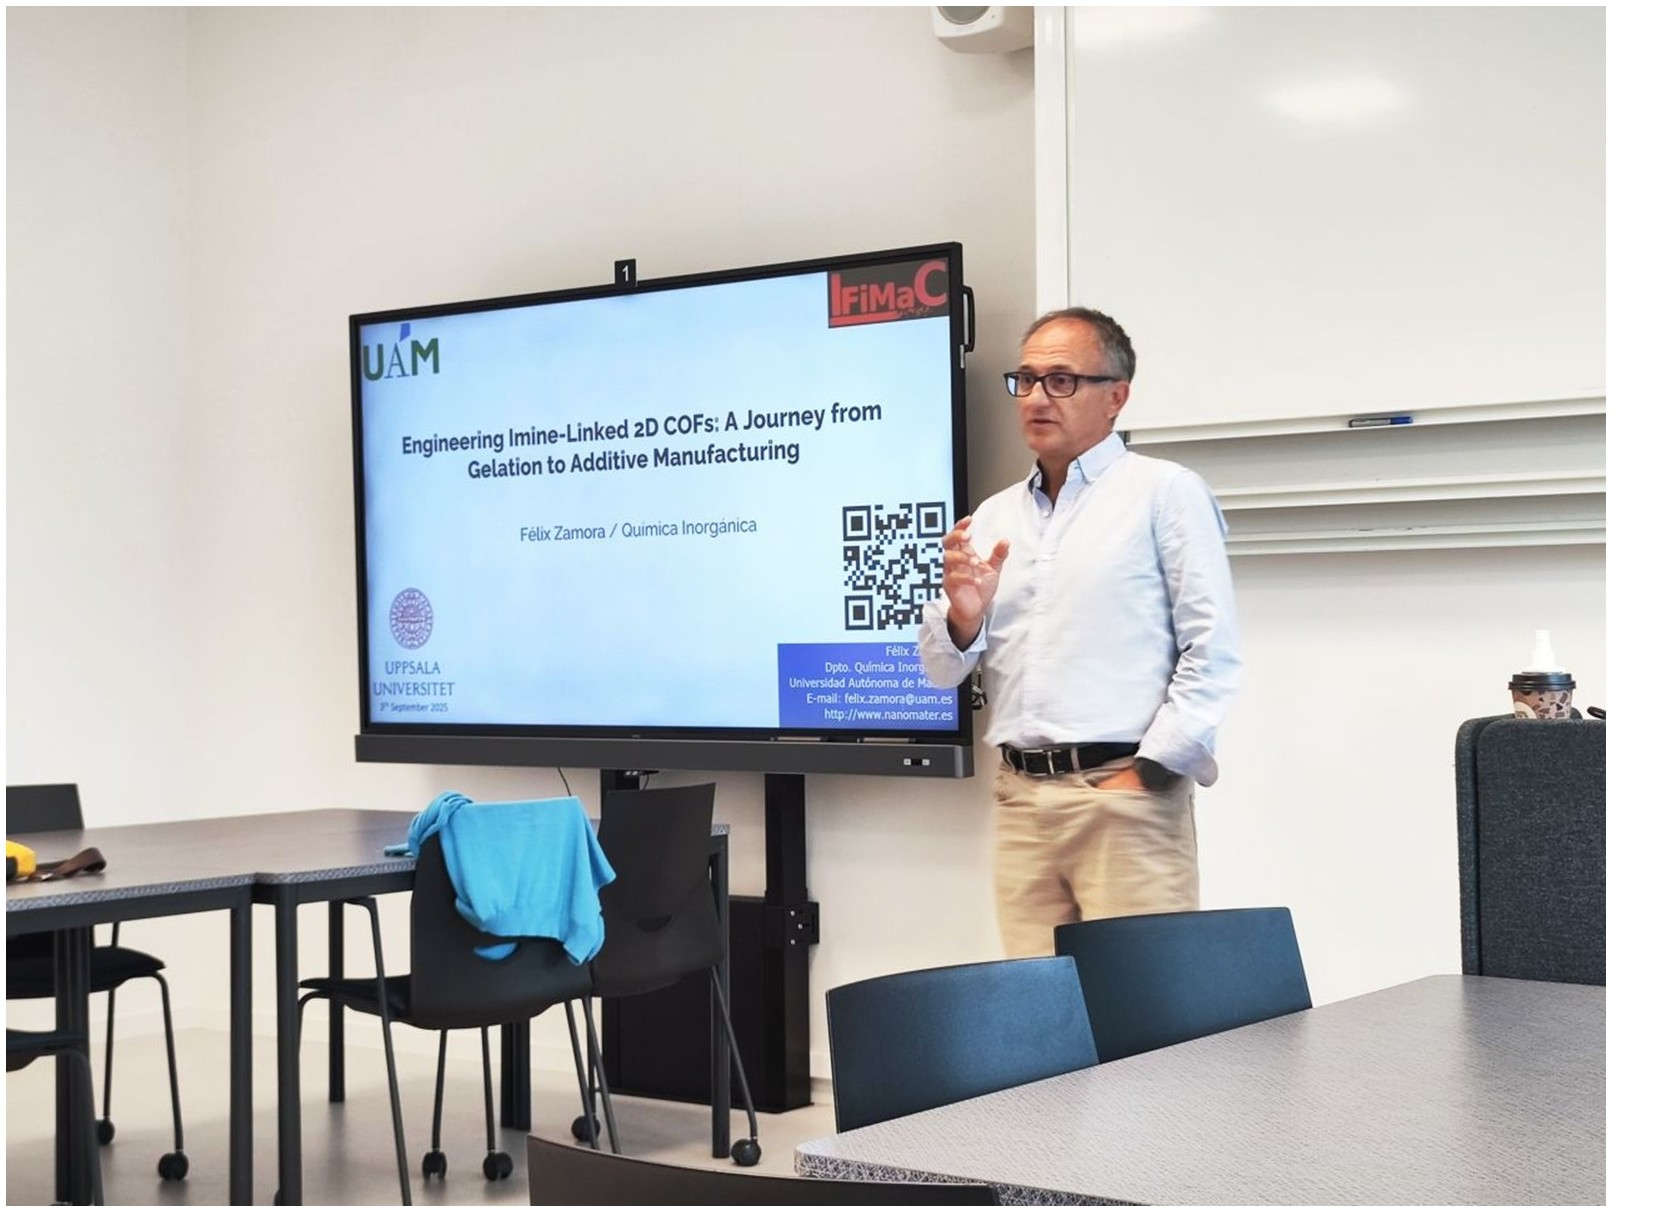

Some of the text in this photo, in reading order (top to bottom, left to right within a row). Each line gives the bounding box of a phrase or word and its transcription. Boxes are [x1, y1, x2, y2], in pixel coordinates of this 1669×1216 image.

[622, 265, 629, 282] 1
[402, 402, 882, 458] Engineering Imine-Linked 2D COFs: A Journey from
[468, 440, 800, 479] Gelation to Additive Manufacturing
[520, 525, 550, 542] Félix
[554, 524, 606, 541] Zamora
[609, 522, 618, 539] /
[682, 517, 757, 538] Inorgánica
[385, 661, 441, 675] UPPSALA
[825, 662, 851, 675] Dpto.
[373, 681, 455, 696] UNIVERSITET
[789, 677, 846, 689] Universidad
[848, 677, 898, 689] Autónoma
[902, 677, 915, 688] de
[807, 693, 953, 705] E-mail: felix.zamora@uam.es
[824, 708, 953, 722] http://www.nanomater.es
